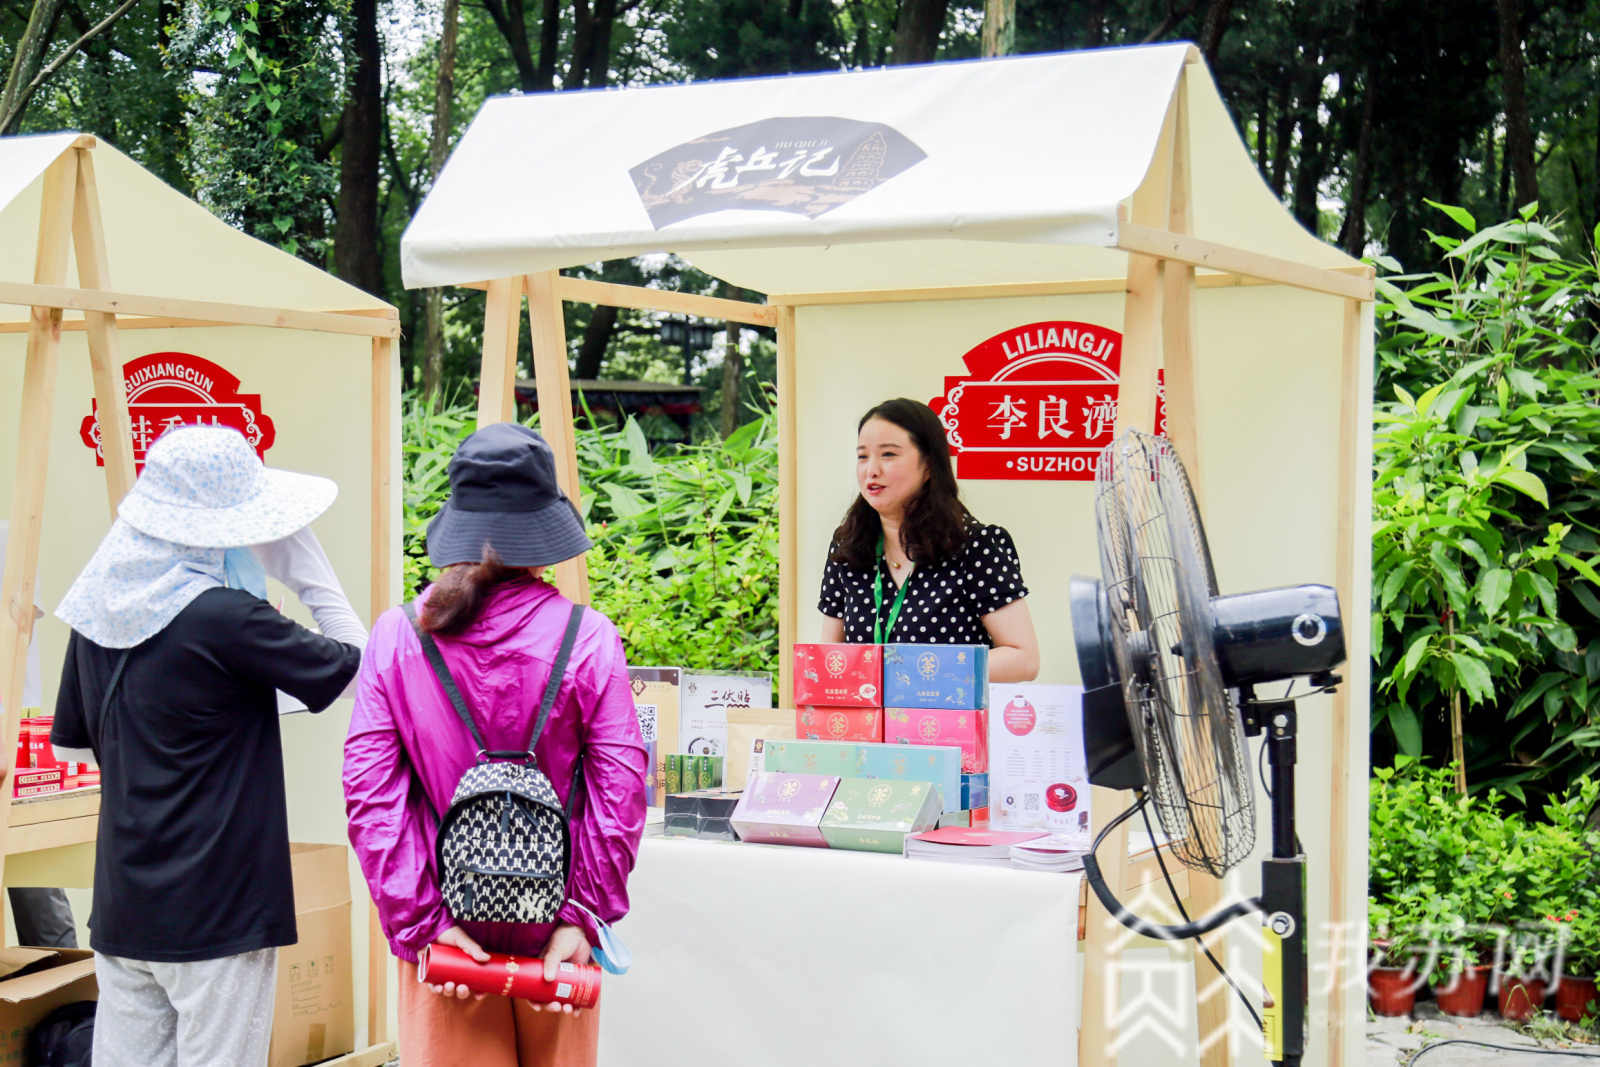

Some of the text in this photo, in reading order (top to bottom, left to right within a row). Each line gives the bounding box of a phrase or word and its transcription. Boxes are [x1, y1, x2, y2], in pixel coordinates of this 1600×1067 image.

[794, 140, 816, 148] QIU
[817, 139, 829, 147] JI
[666, 146, 841, 196] 虎丘记
[1002, 328, 1114, 362] LILIANGJI
[125, 363, 214, 393] GUIXIANGCUN
[829, 654, 843, 672] 茶
[921, 656, 936, 673] 茶
[704, 689, 750, 708] 三伏贴
[831, 715, 845, 734] 茶
[922, 719, 937, 737] 茶
[803, 753, 817, 771] 茶
[892, 758, 906, 776] 茶
[782, 782, 797, 797] 茶
[872, 787, 888, 802] 茶
